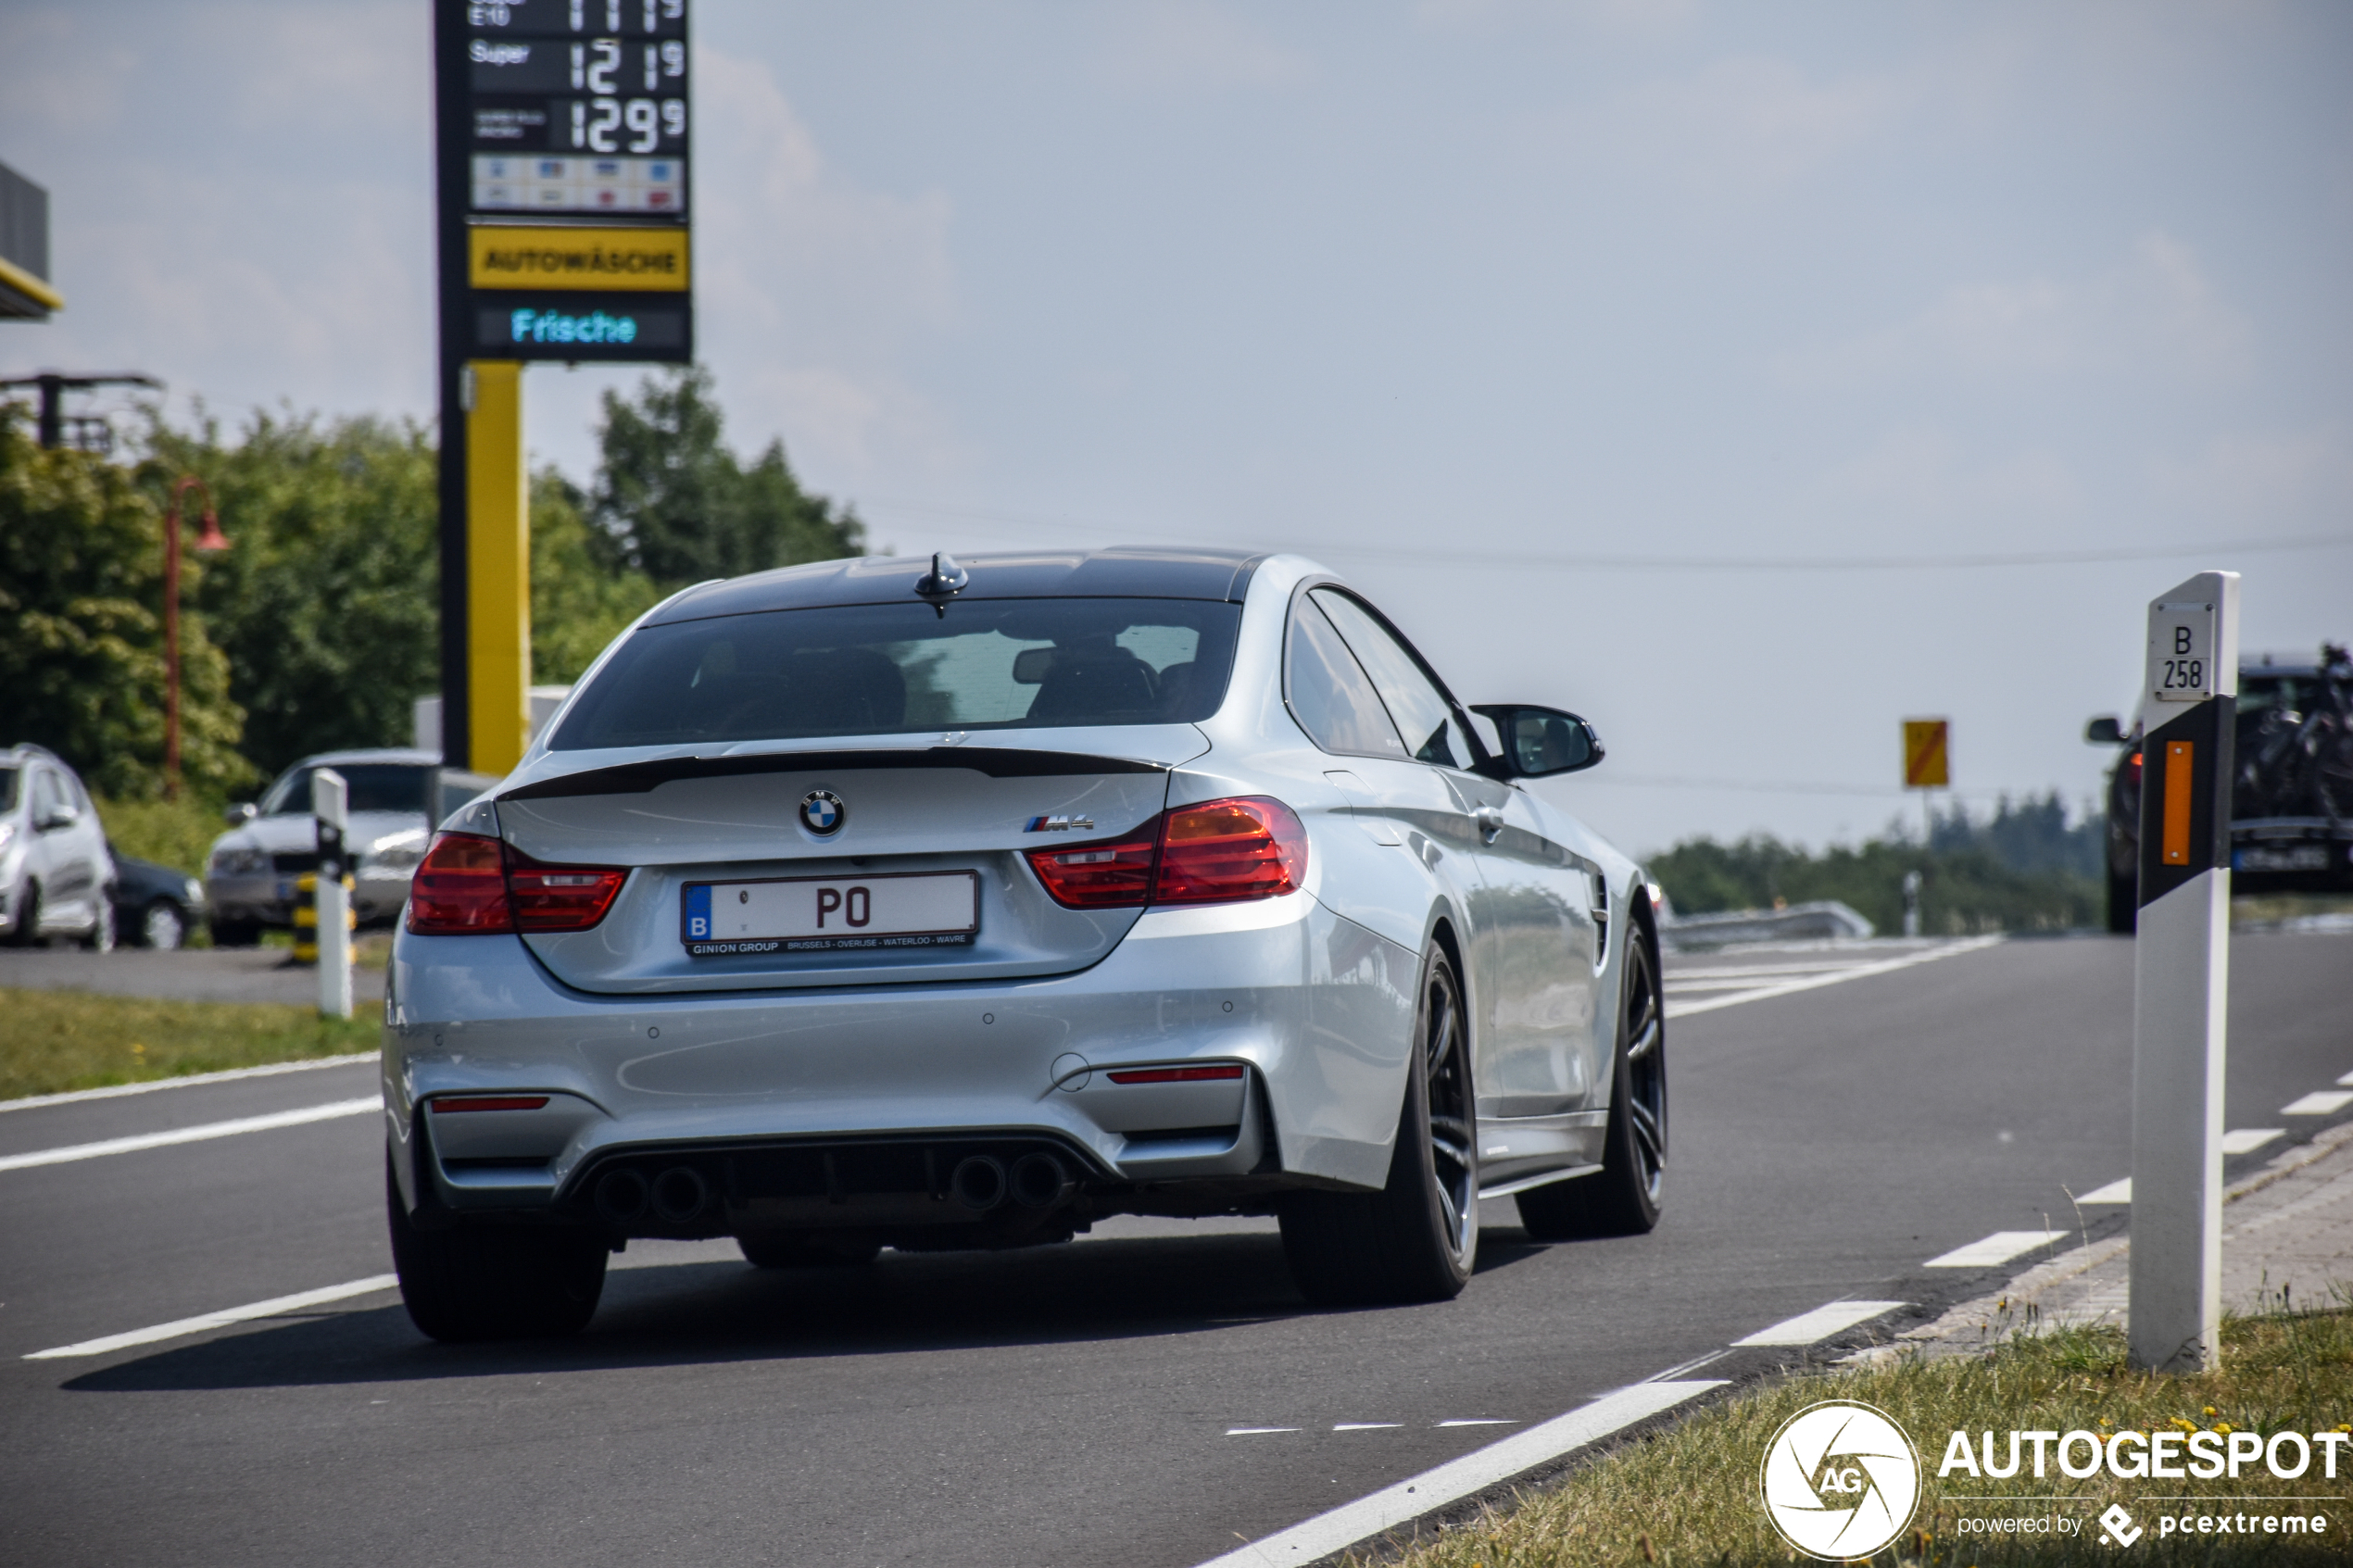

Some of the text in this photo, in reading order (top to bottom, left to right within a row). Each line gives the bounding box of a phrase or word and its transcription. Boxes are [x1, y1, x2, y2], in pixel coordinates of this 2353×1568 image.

[470, 39, 530, 66] Super
[510, 309, 637, 343] Frische
[2175, 626, 2192, 655] B
[2164, 660, 2202, 688] 258
[802, 791, 840, 807] BMW
[691, 917, 707, 936] B
[693, 935, 966, 954] GINION GROUP BRUSSELS OVERIJSE WATERLOO WAVRE
